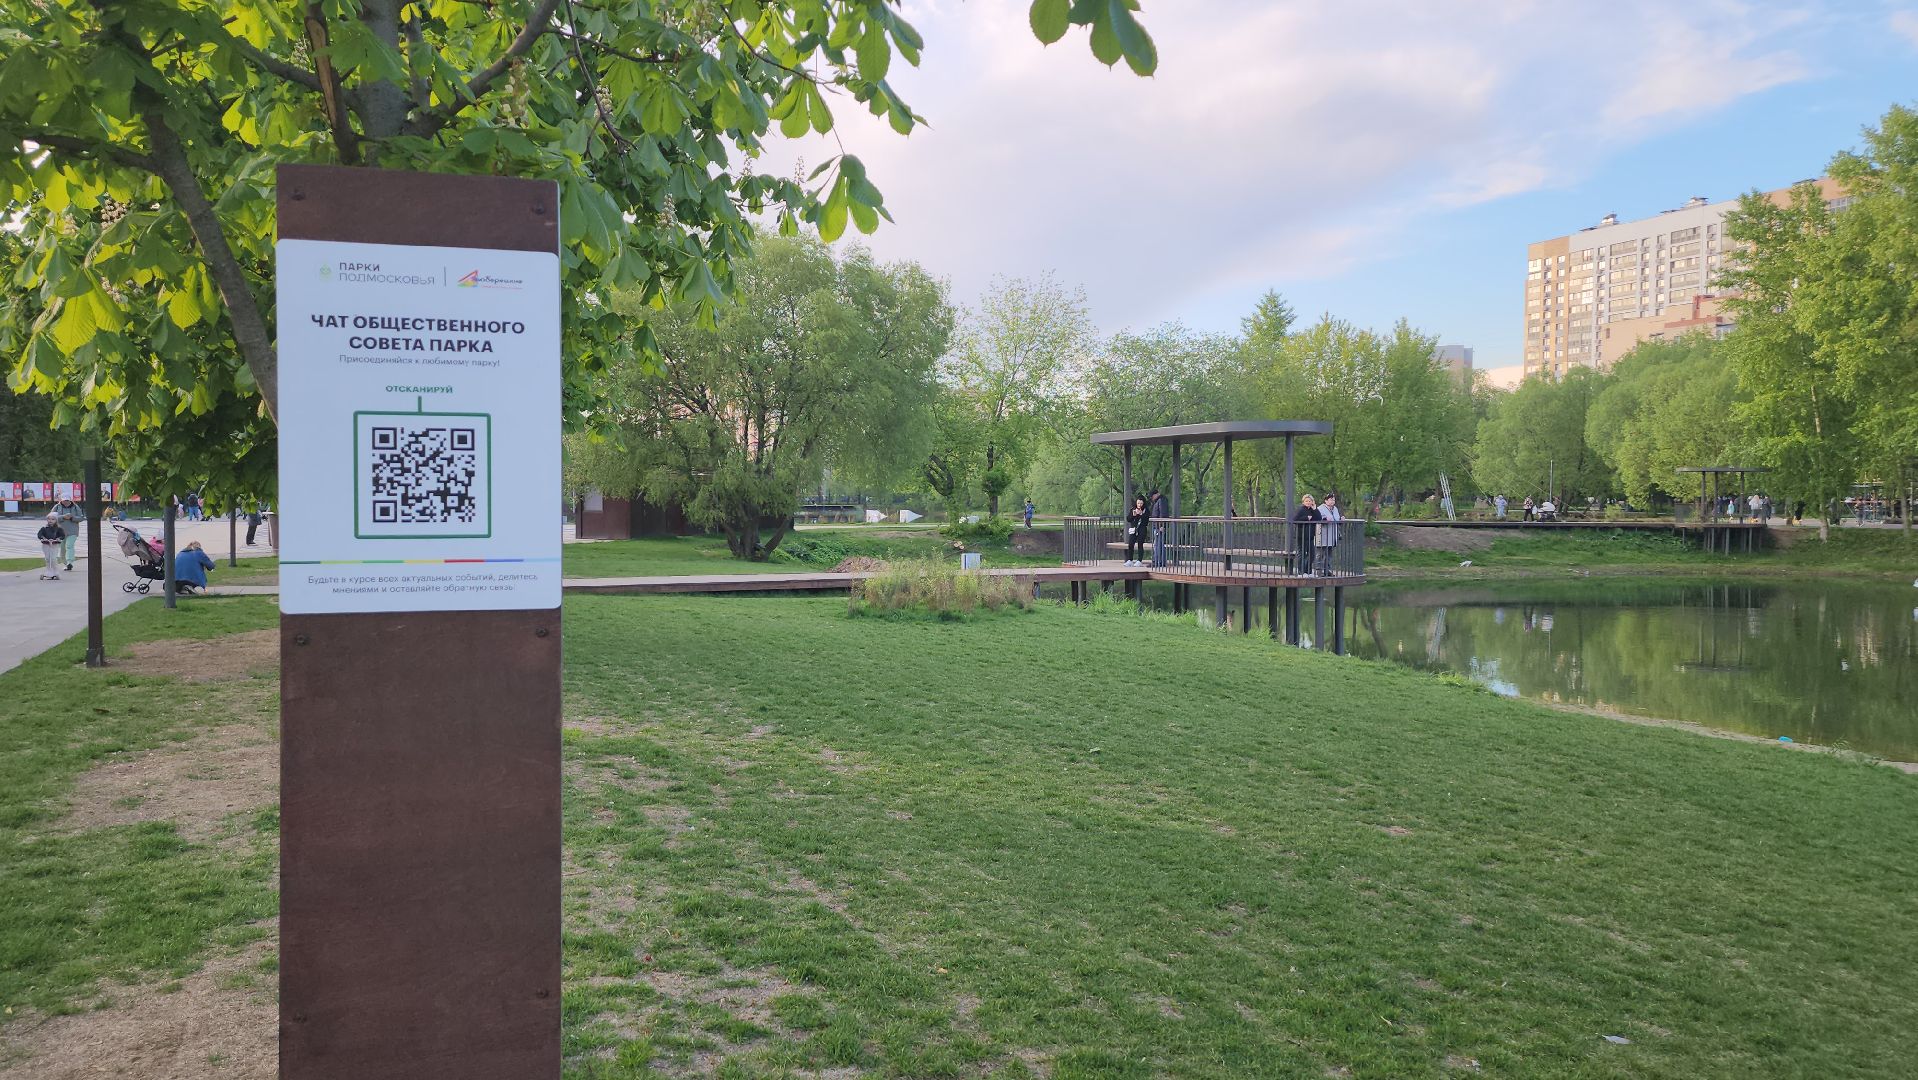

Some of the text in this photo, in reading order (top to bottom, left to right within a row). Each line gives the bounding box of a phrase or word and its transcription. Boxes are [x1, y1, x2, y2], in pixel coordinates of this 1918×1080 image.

[339, 262, 380, 272] ПАРКИ
[339, 272, 435, 285] ПОДМОСКОВЬЯ
[311, 314, 525, 334] ЧАТ ОБЩЕСТВЕННОГО
[349, 336, 494, 353] СОВЕТА ПАРКА
[339, 354, 413, 365] Присоединяйся
[422, 357, 469, 367] любимому
[472, 359, 500, 368] парку!
[385, 384, 453, 394] ОТСКАНИРУЙ
[308, 576, 339, 585] Будьте
[349, 576, 376, 584] курсе
[378, 575, 399, 583] всех
[401, 574, 453, 583] актуальных
[455, 573, 496, 582] событий,
[498, 573, 538, 582] делитесь
[332, 586, 379, 594] мнениями
[389, 584, 441, 593] оставляйте
[443, 583, 487, 593] обратную
